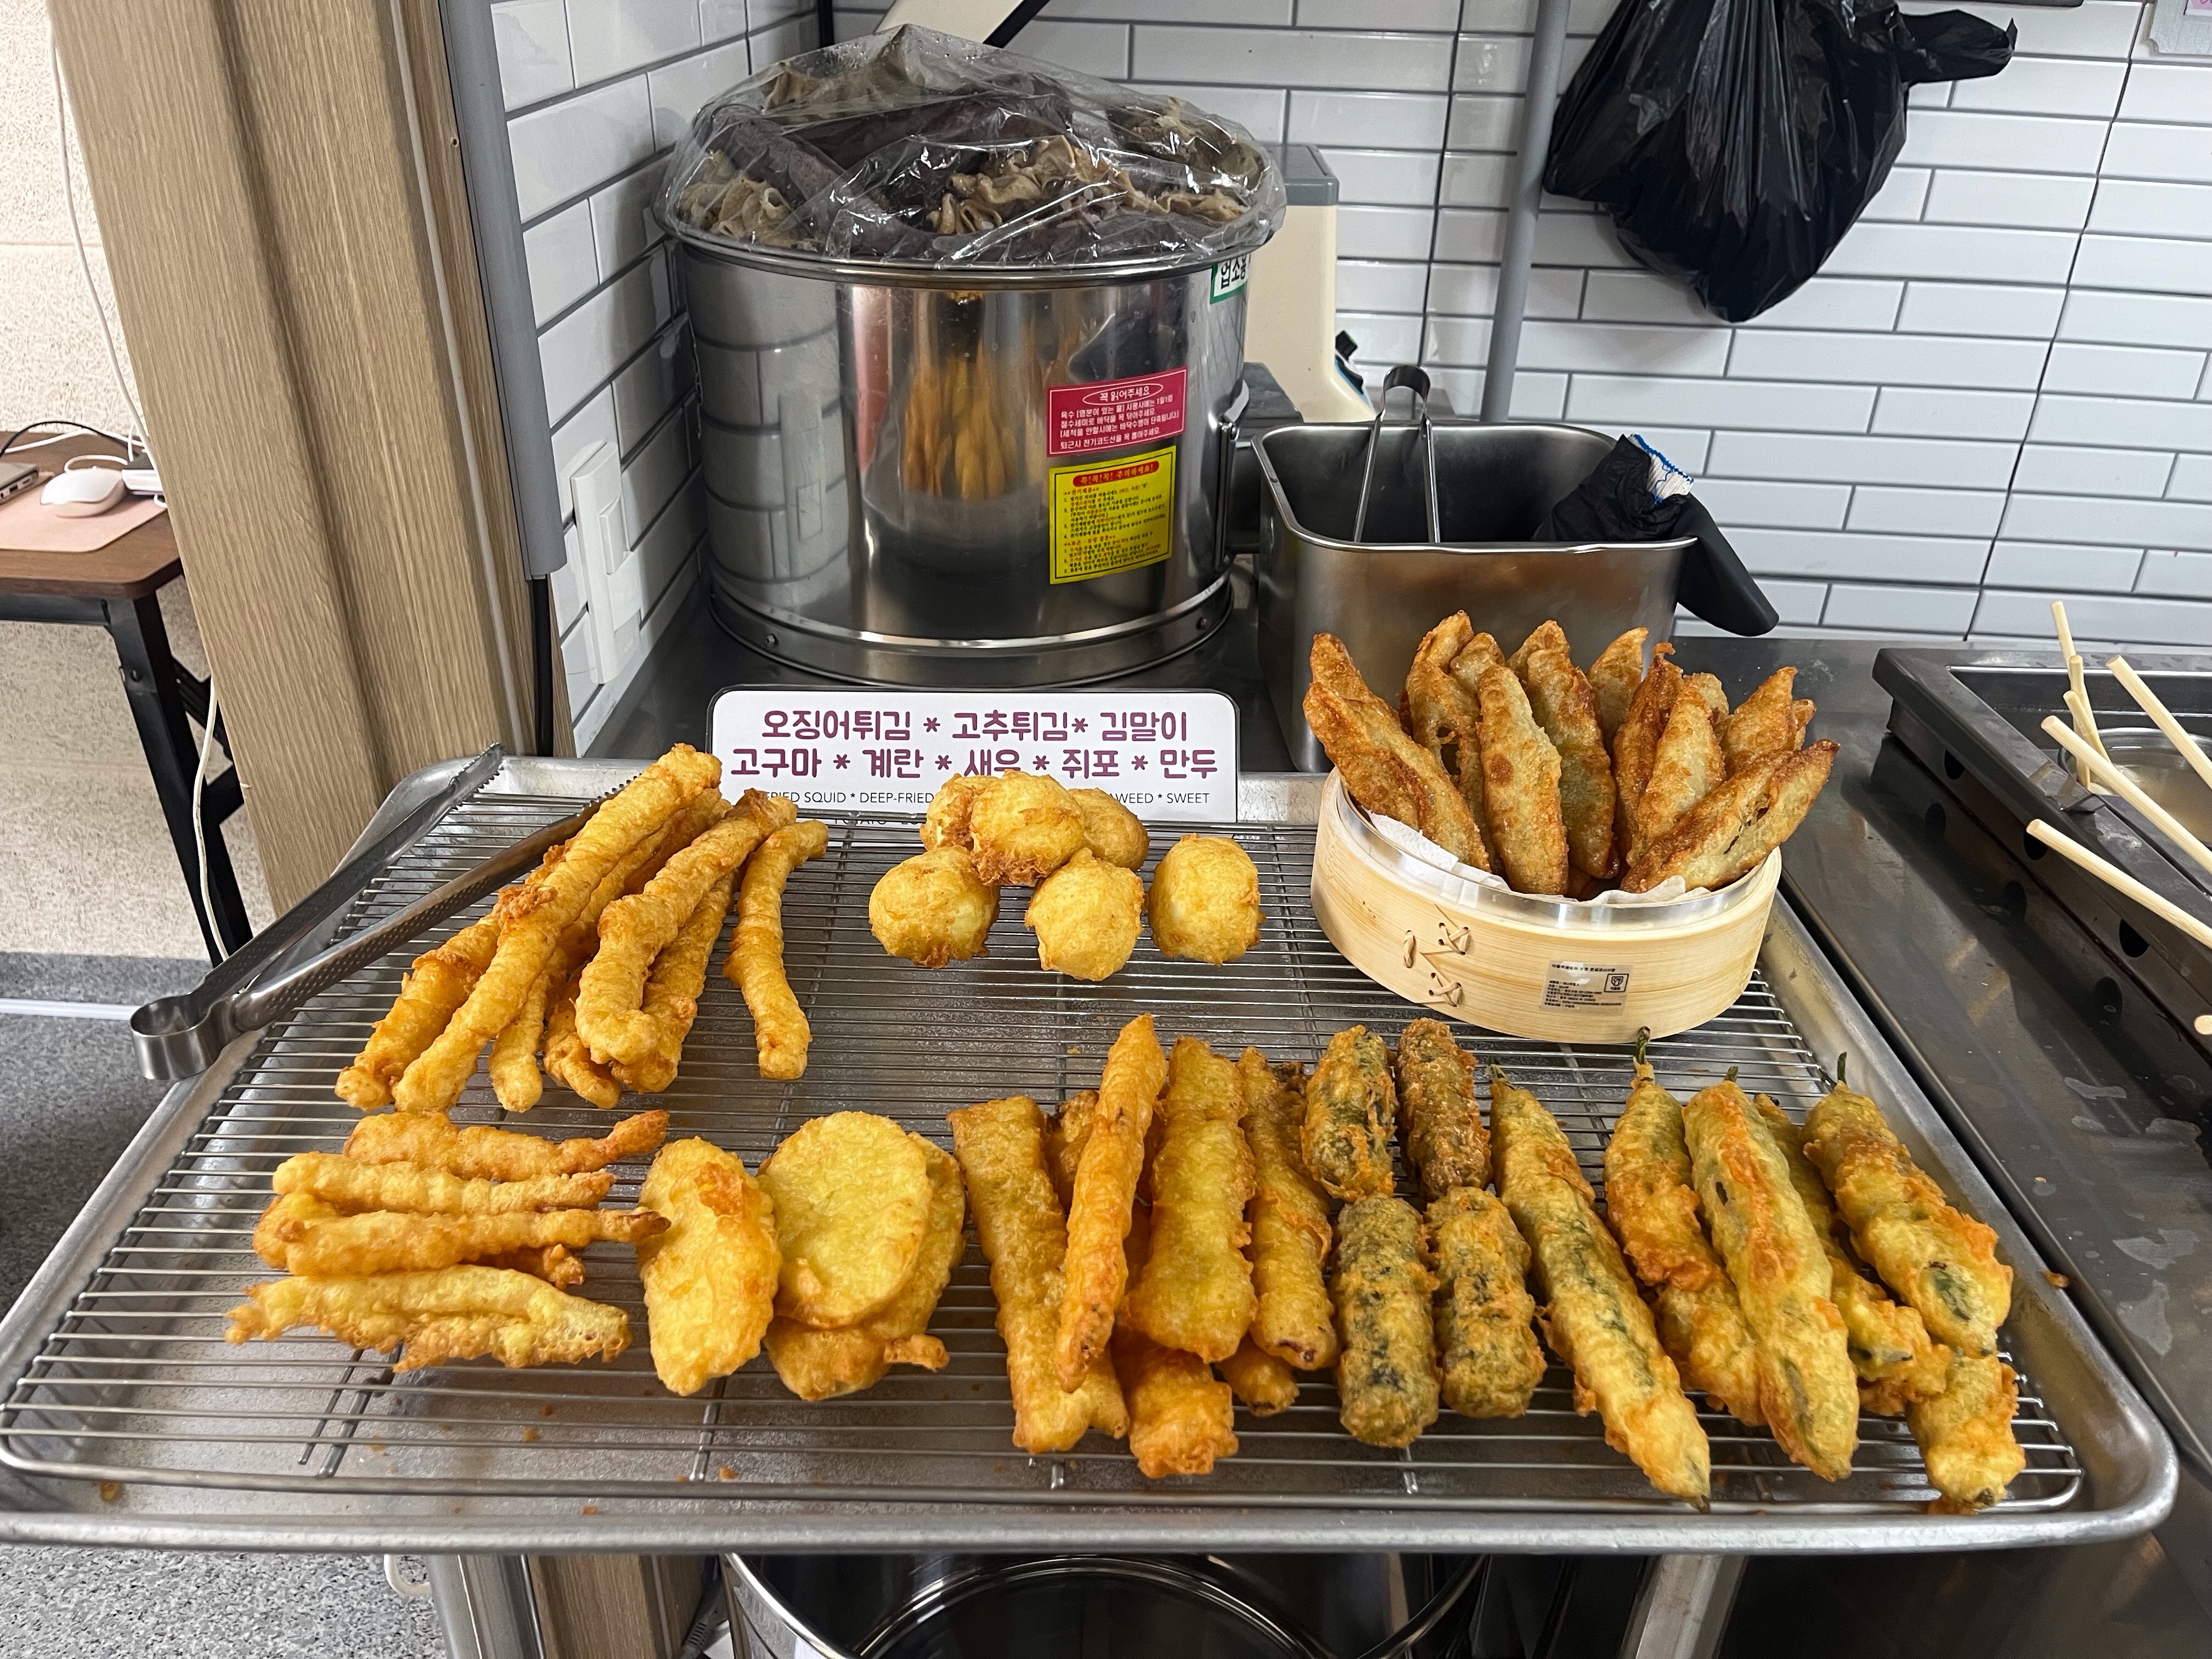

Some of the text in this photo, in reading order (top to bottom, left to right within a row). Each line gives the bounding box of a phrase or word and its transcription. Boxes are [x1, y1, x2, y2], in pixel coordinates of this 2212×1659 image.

[1099, 386, 1150, 402] 꼭 읽어주세요
[762, 710, 1187, 742] 오징어튀김 고추튀김 김말이
[731, 748, 1218, 779] 고구마 계란 새우 쥐포 만두
[804, 792, 846, 803] SQUID
[860, 792, 934, 803] DEEP-FRIED
[1166, 793, 1210, 804] SWEET
